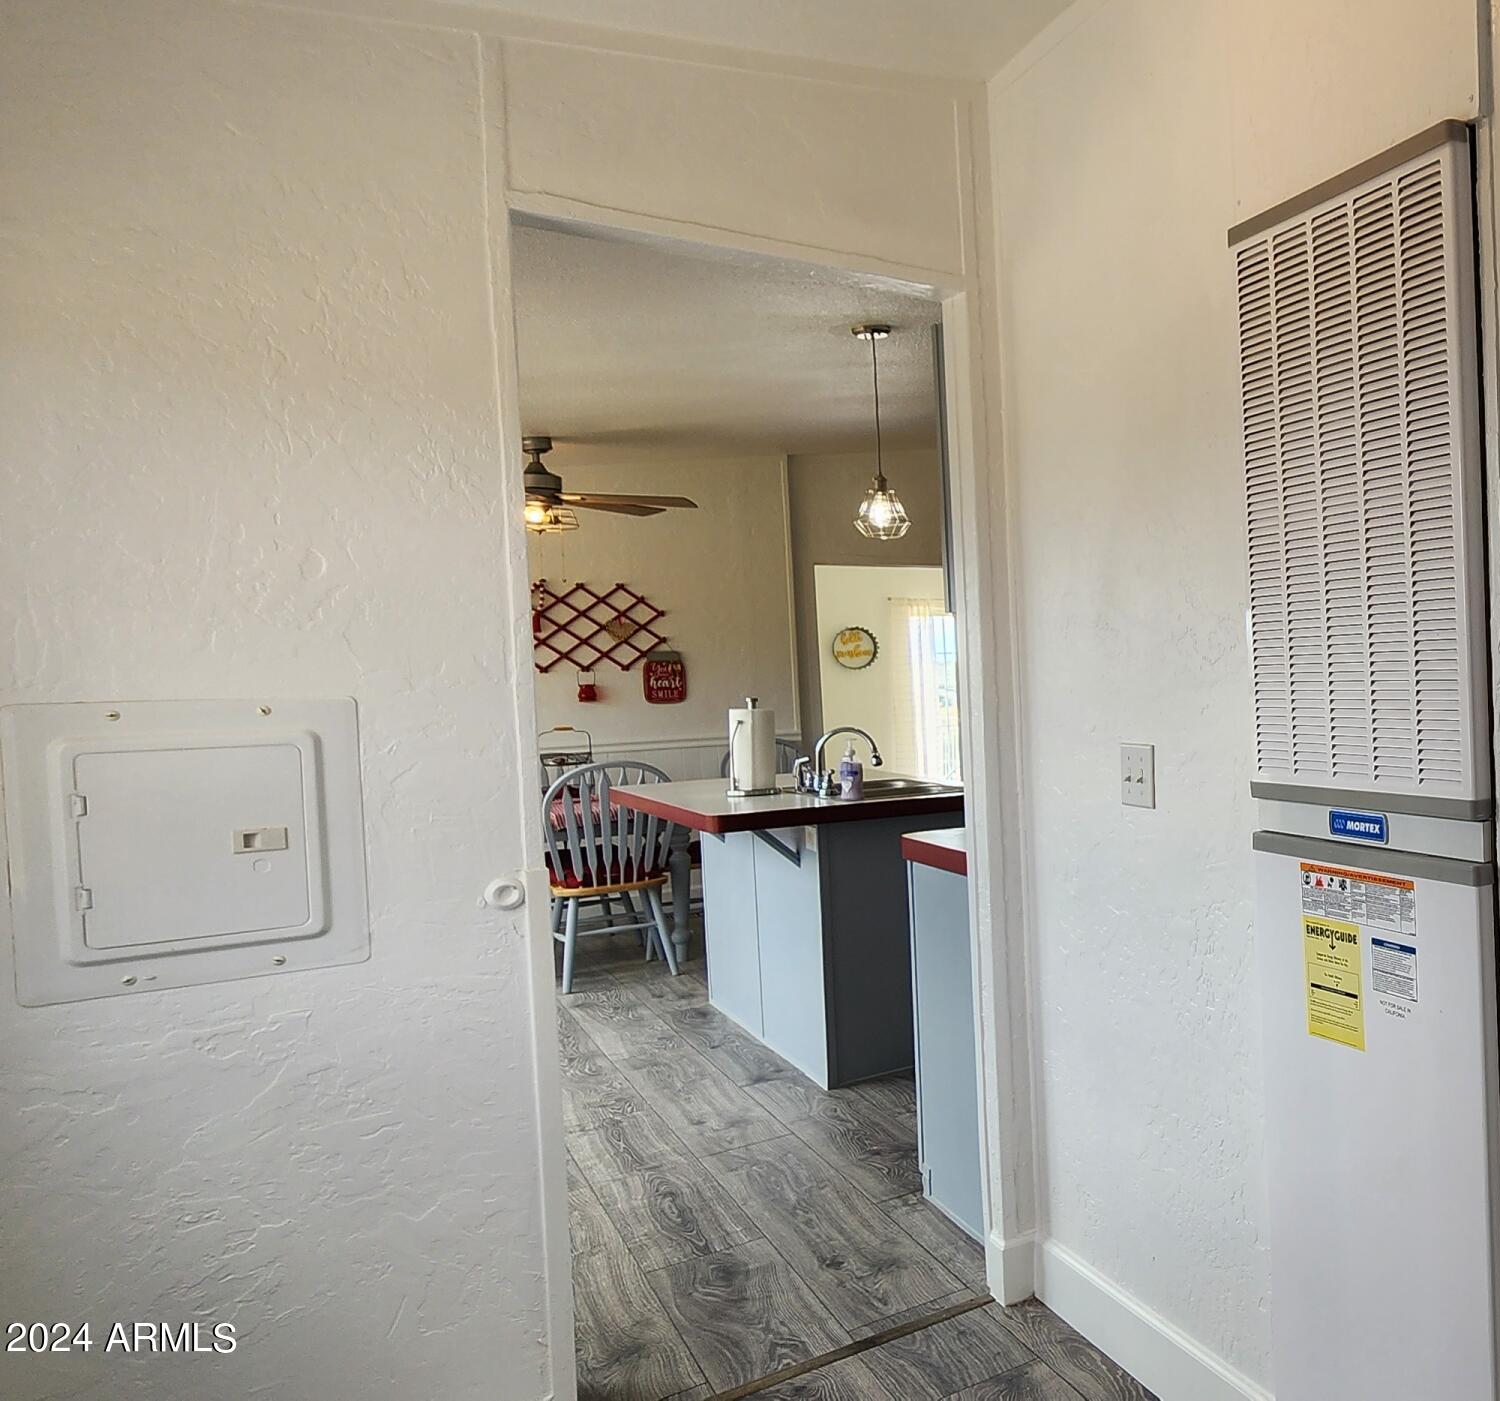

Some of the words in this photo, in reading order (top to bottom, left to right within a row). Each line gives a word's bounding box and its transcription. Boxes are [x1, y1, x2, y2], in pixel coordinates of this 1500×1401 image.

[650, 676, 682, 689] heart
[651, 690, 679, 699] SMILE
[1346, 820, 1381, 834] MORTEX
[1306, 924, 1358, 945] ENERGYGUIDE
